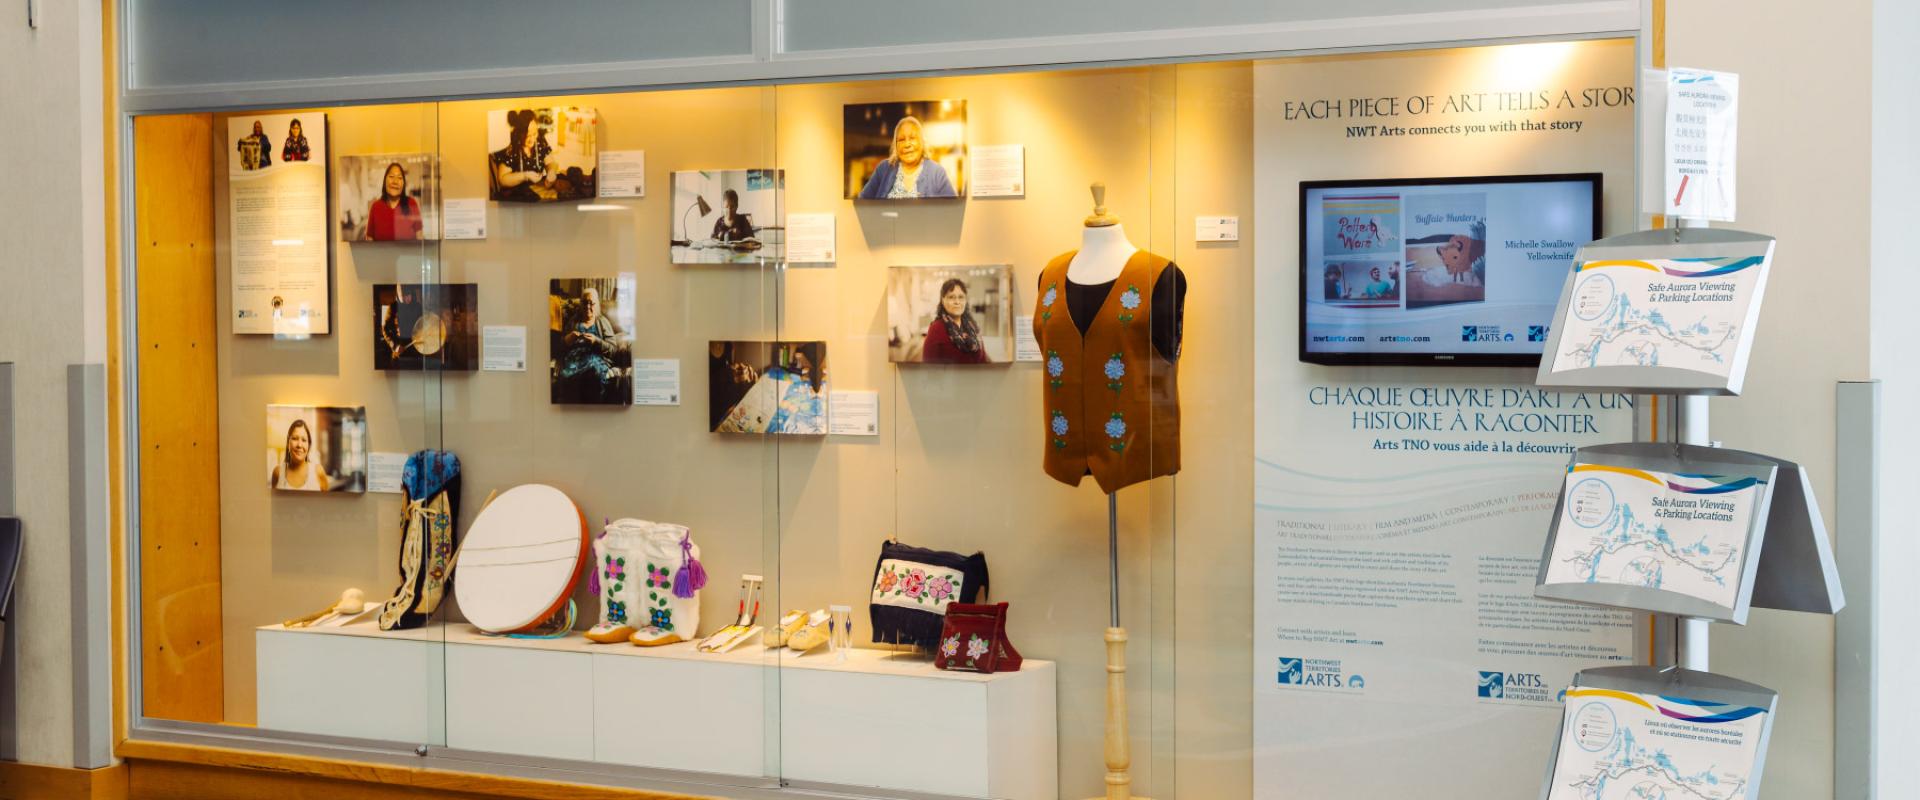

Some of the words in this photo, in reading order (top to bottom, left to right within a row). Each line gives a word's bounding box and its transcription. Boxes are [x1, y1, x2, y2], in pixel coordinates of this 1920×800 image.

[1284, 99, 1342, 120] EACH
[1349, 97, 1399, 117] PIECE
[1407, 95, 1434, 115] OF
[1442, 93, 1488, 113] ART
[1494, 90, 1550, 111] TELLS
[1556, 89, 1576, 109] A
[1346, 126, 1376, 138] NWT
[1379, 126, 1406, 137] Arts
[1408, 123, 1461, 136] connects
[1464, 122, 1486, 136] you
[1489, 120, 1517, 133] with
[1520, 119, 1546, 132] that
[1550, 120, 1583, 133] story
[1415, 213, 1444, 225] Buffalo
[1446, 212, 1477, 222] Hunters
[1505, 240, 1539, 249] Michelle
[1540, 239, 1575, 249] Swallow
[1527, 252, 1575, 261] Yellowknife
[1648, 283, 1666, 292] Safe
[1667, 283, 1697, 292] Aurora
[1699, 281, 1736, 292] Viewing
[1650, 293, 1656, 303] &
[1658, 293, 1691, 304] Parking
[1692, 293, 1733, 302] Locations
[1313, 335, 1365, 343] nwtarts.com
[1309, 387, 1402, 407] CHAQUE
[1410, 387, 1494, 408] ŒUVRE
[1352, 411, 1443, 431] HISTOIRE
[1450, 408, 1468, 431] À
[1475, 412, 1600, 434] RACONTER
[1373, 438, 1399, 450] Arts
[1402, 439, 1430, 451] TNO
[1433, 442, 1460, 451] vous
[1463, 440, 1489, 452] aide
[1492, 441, 1499, 452] à
[1502, 440, 1513, 453] la
[1652, 497, 1669, 507] Safe
[1670, 498, 1697, 508] Aurora
[1699, 499, 1736, 513] Viewing
[1654, 509, 1661, 517] &
[1663, 509, 1692, 521] Parking
[1693, 510, 1733, 522] Locations
[1305, 665, 1341, 673] TERRITORIES
[1304, 673, 1341, 688] ARTS
[1505, 673, 1541, 688] ARTS
[1505, 694, 1549, 702] NORD-OUEST
